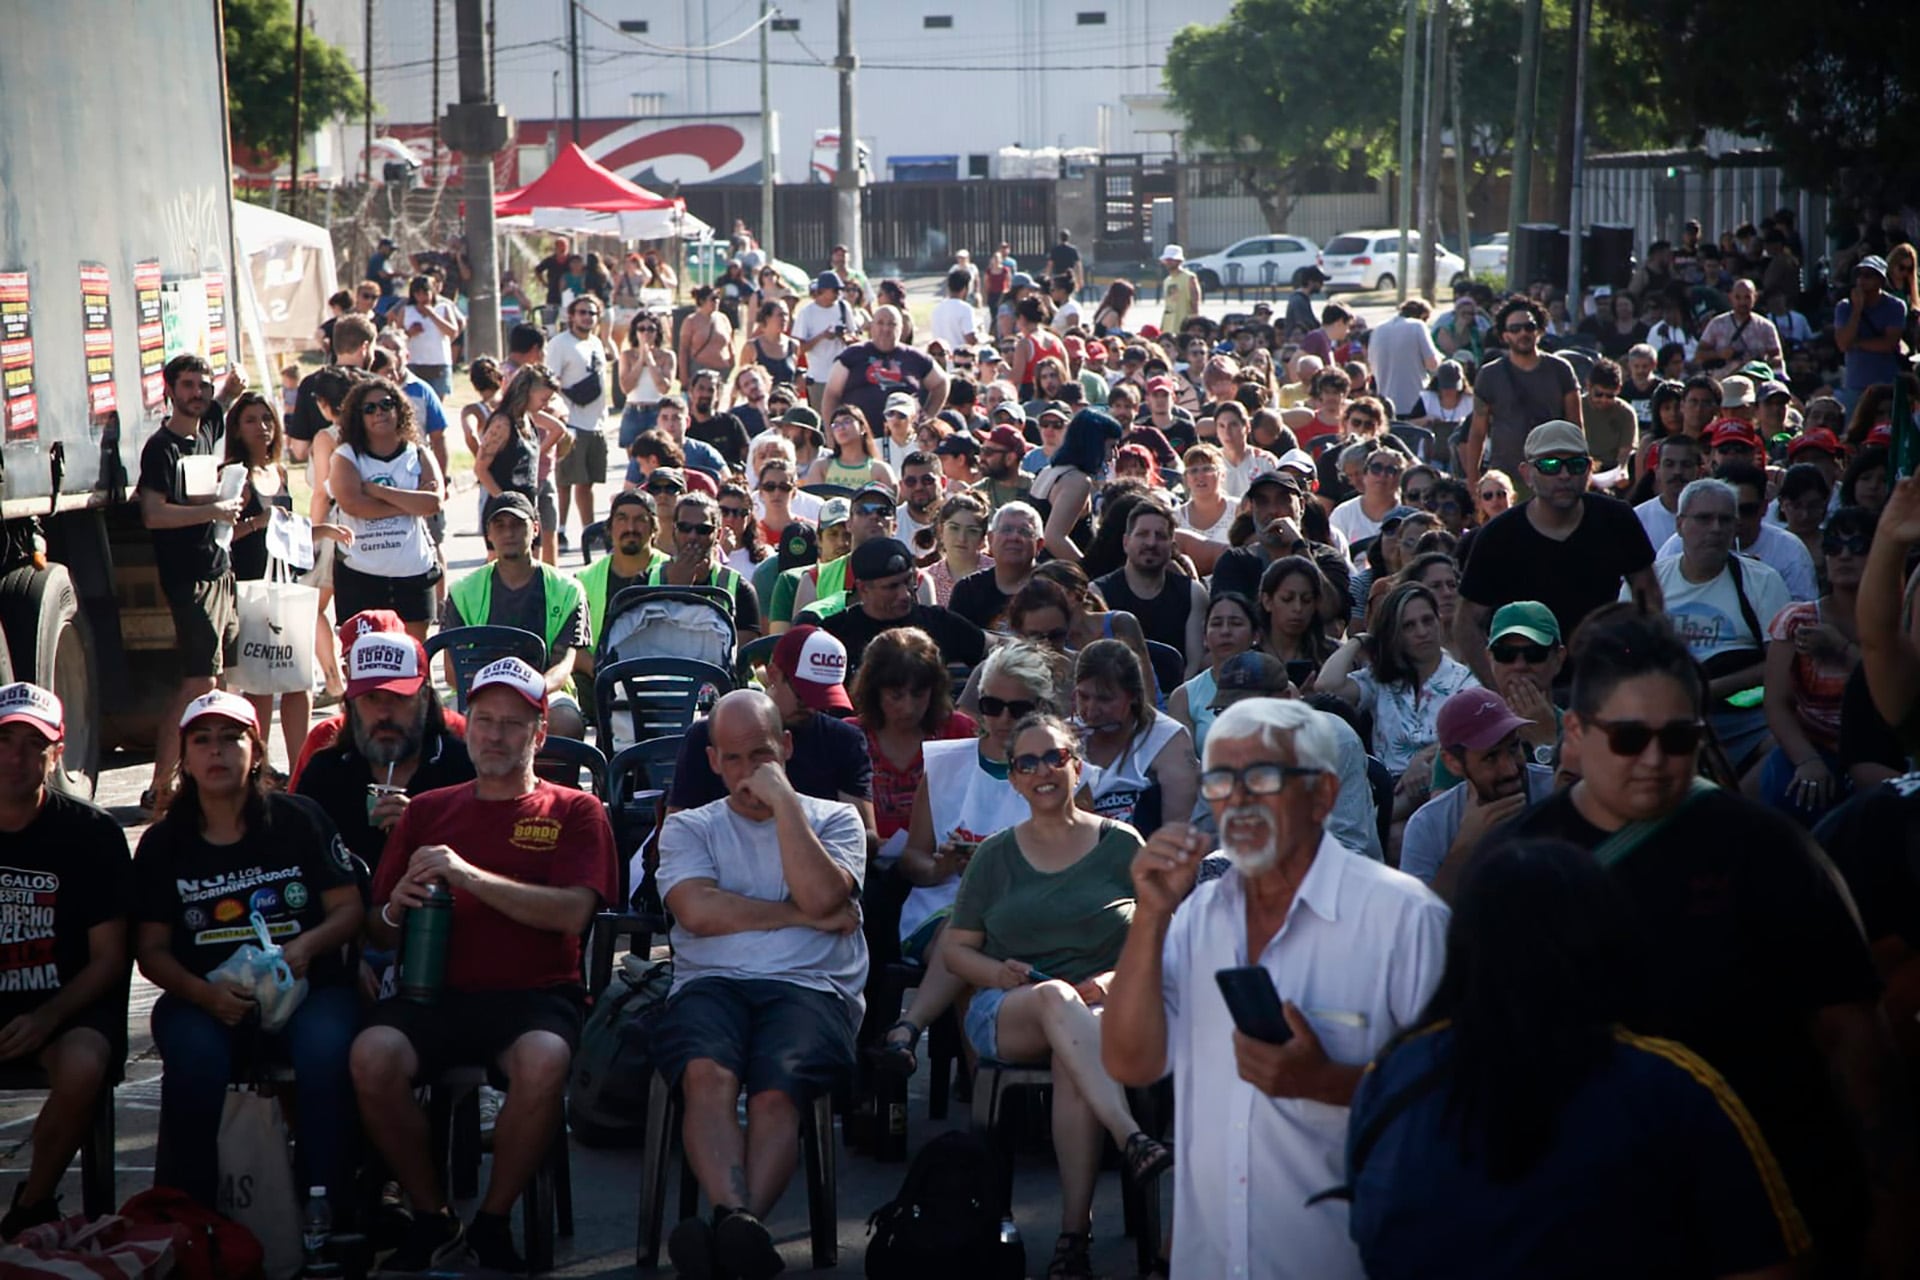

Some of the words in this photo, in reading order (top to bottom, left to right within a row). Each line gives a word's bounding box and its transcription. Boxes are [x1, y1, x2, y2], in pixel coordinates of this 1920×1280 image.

[361, 540, 402, 552] Garrahan
[355, 617, 372, 635] LA
[239, 866, 263, 880] LOS
[0, 904, 55, 927] RECHO
